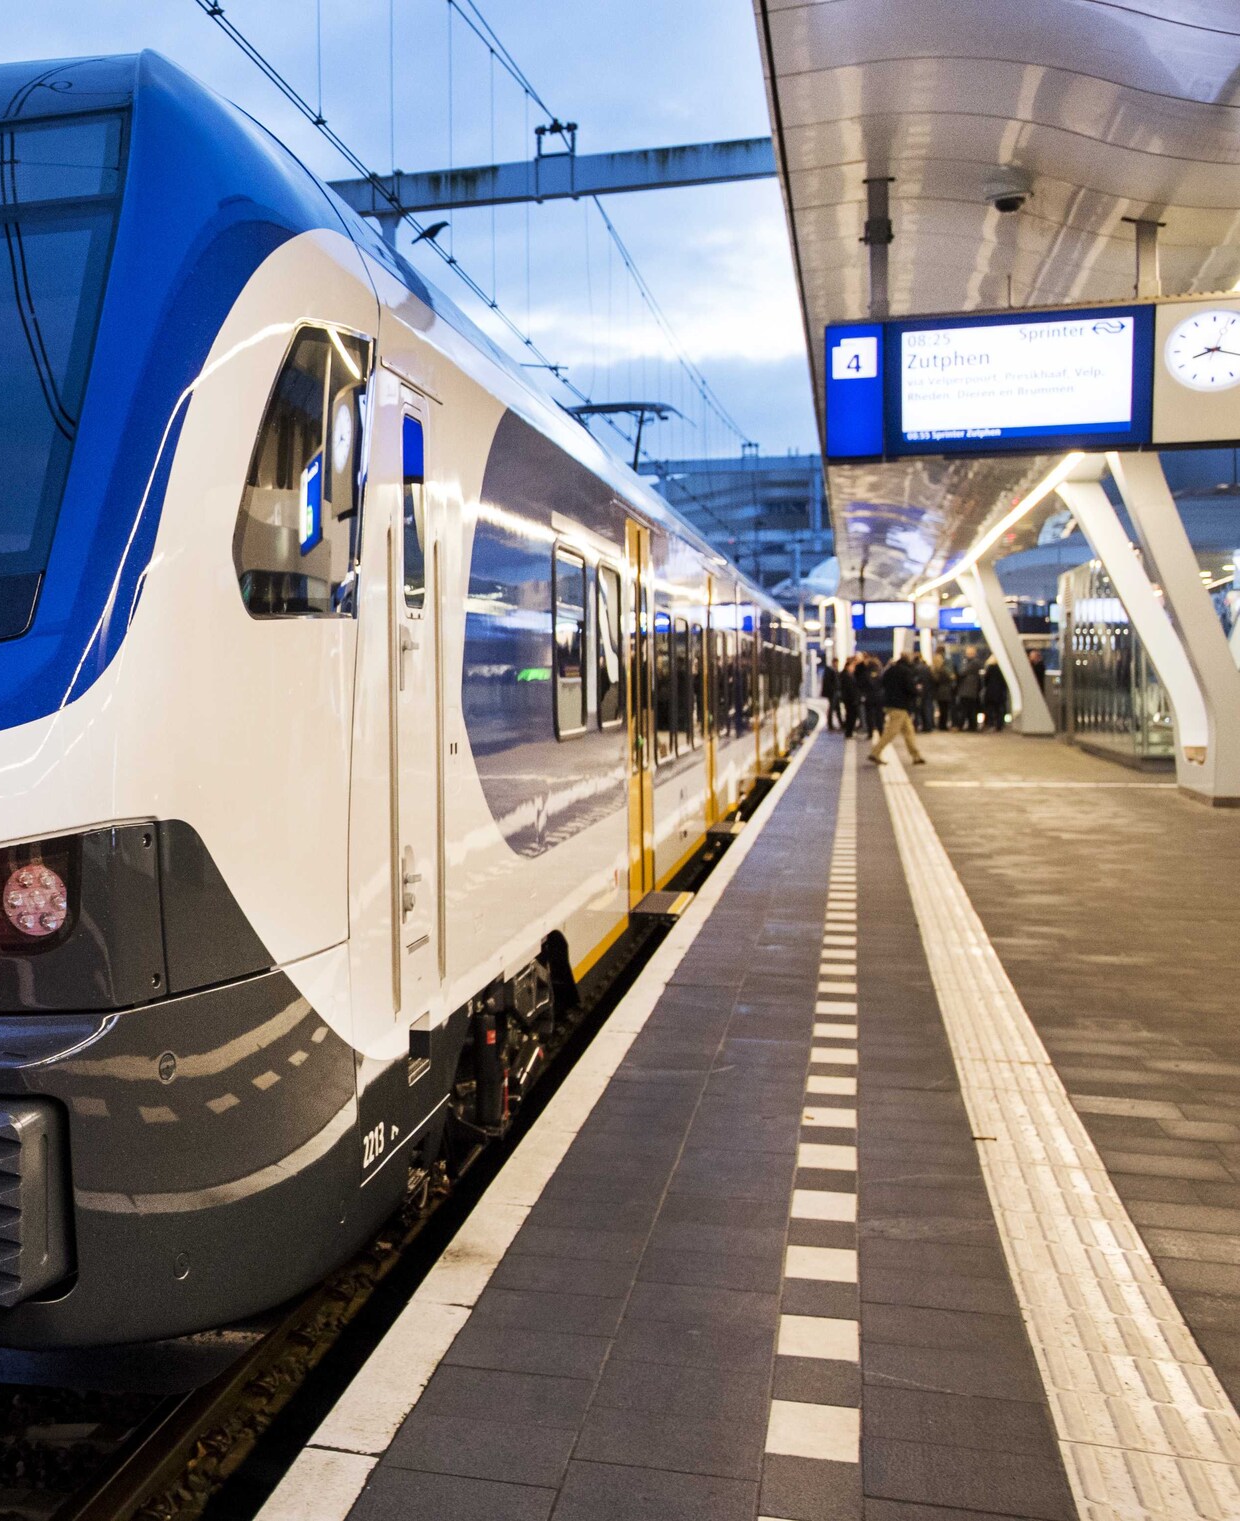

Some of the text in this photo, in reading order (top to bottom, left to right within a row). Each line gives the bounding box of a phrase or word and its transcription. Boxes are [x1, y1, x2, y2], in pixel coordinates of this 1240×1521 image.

[908, 332, 951, 348] 08:25
[1019, 324, 1085, 343] Sprinter
[846, 354, 862, 373] 4
[907, 351, 990, 372] Zutphen
[363, 1121, 384, 1169] 2213
